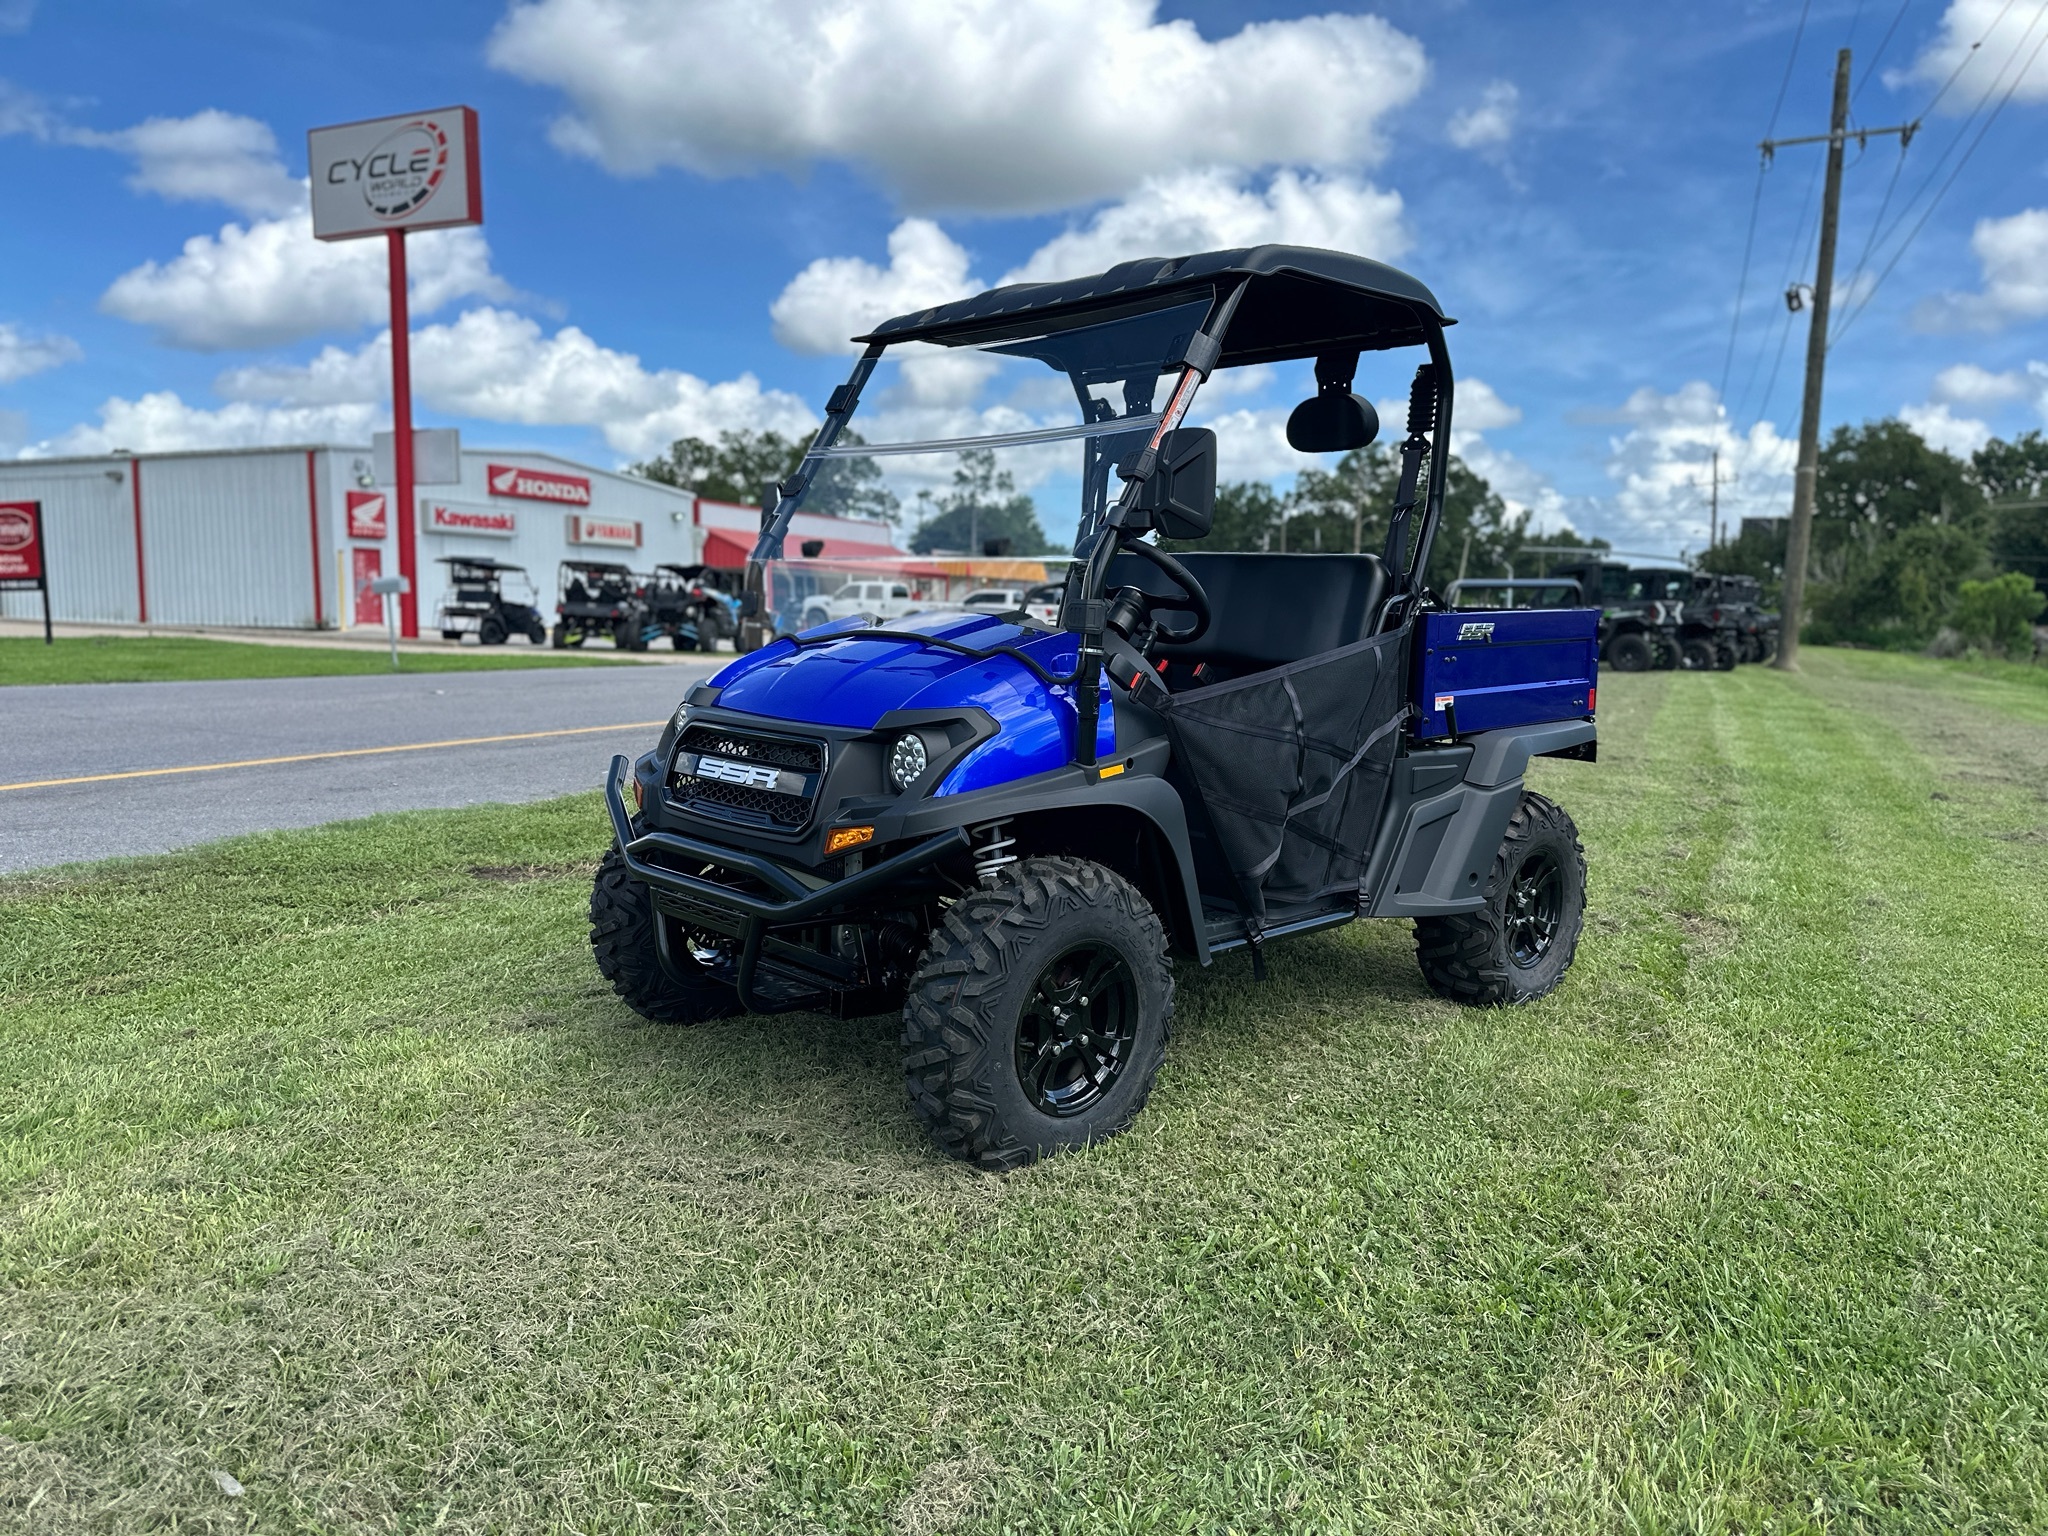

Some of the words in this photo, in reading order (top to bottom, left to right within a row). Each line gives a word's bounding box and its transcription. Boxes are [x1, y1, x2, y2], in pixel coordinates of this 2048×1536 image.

[328, 148, 431, 184] CYCLE
[371, 176, 423, 191] WORLD
[517, 477, 590, 502] HONDA
[435, 506, 514, 530] Kawasaki
[697, 757, 781, 789] SSR
